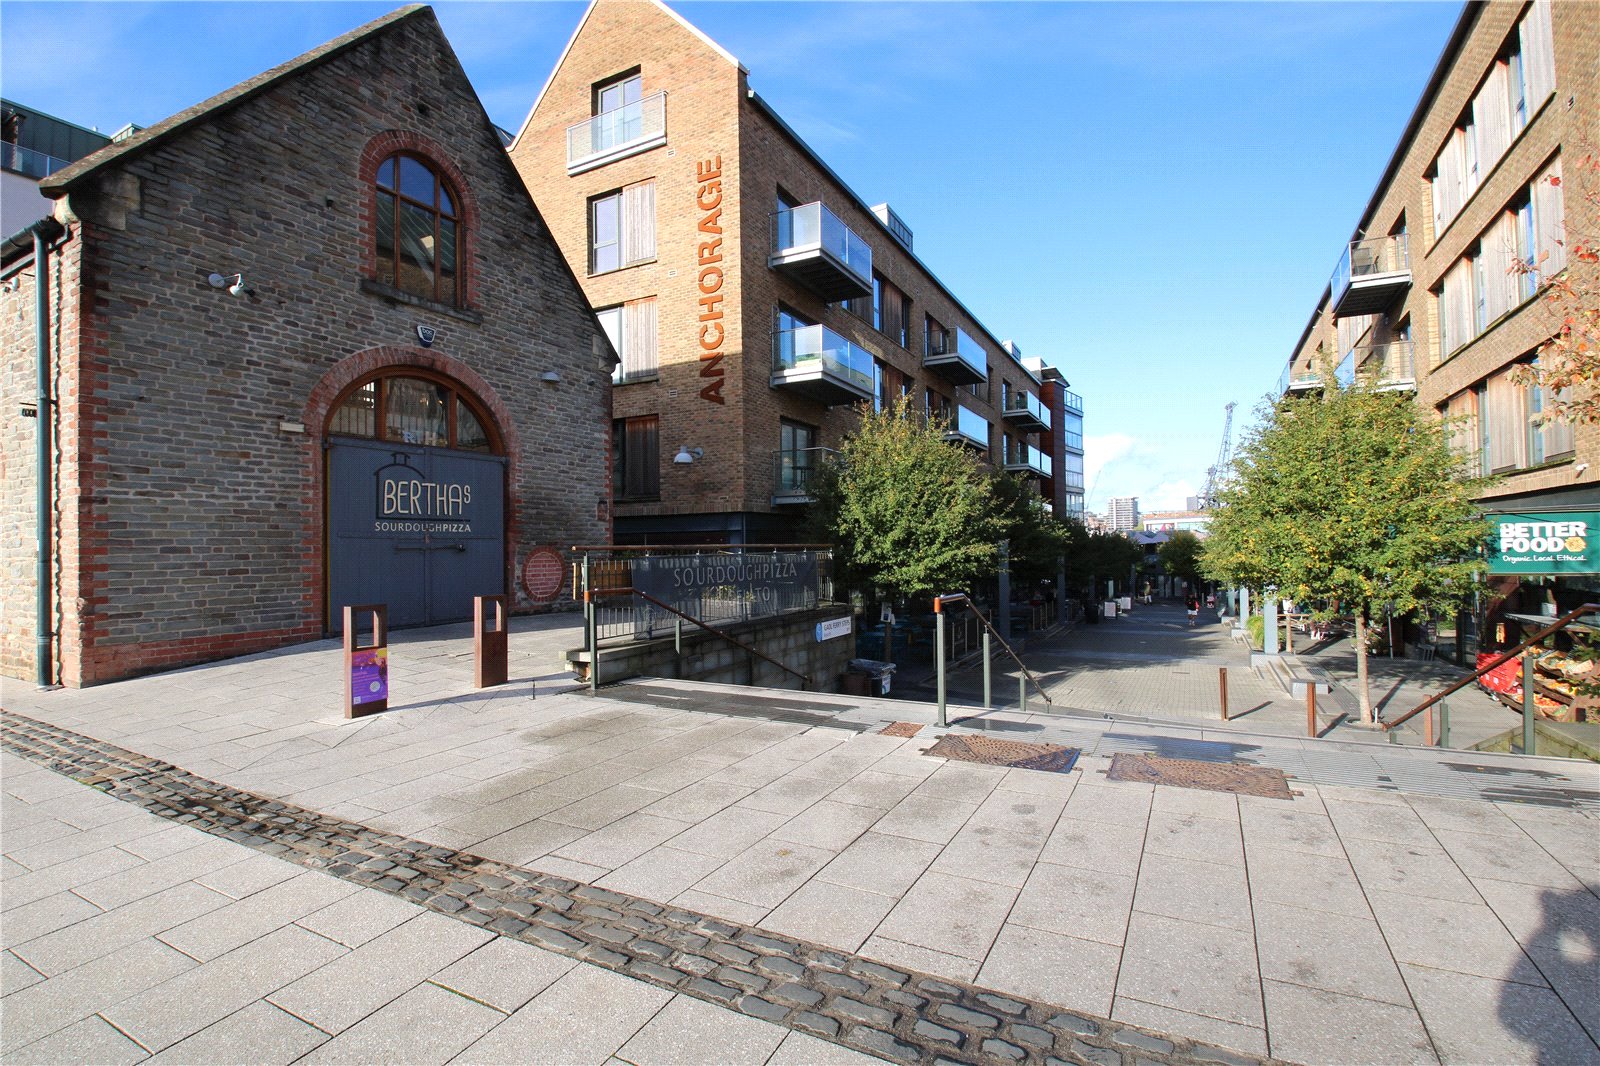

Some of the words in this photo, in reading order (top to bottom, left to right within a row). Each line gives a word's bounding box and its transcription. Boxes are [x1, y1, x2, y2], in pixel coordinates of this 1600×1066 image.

[697, 155, 725, 405] ANCHORAGE
[1500, 521, 1587, 538] BETTER
[1501, 537, 1565, 553] FOOD
